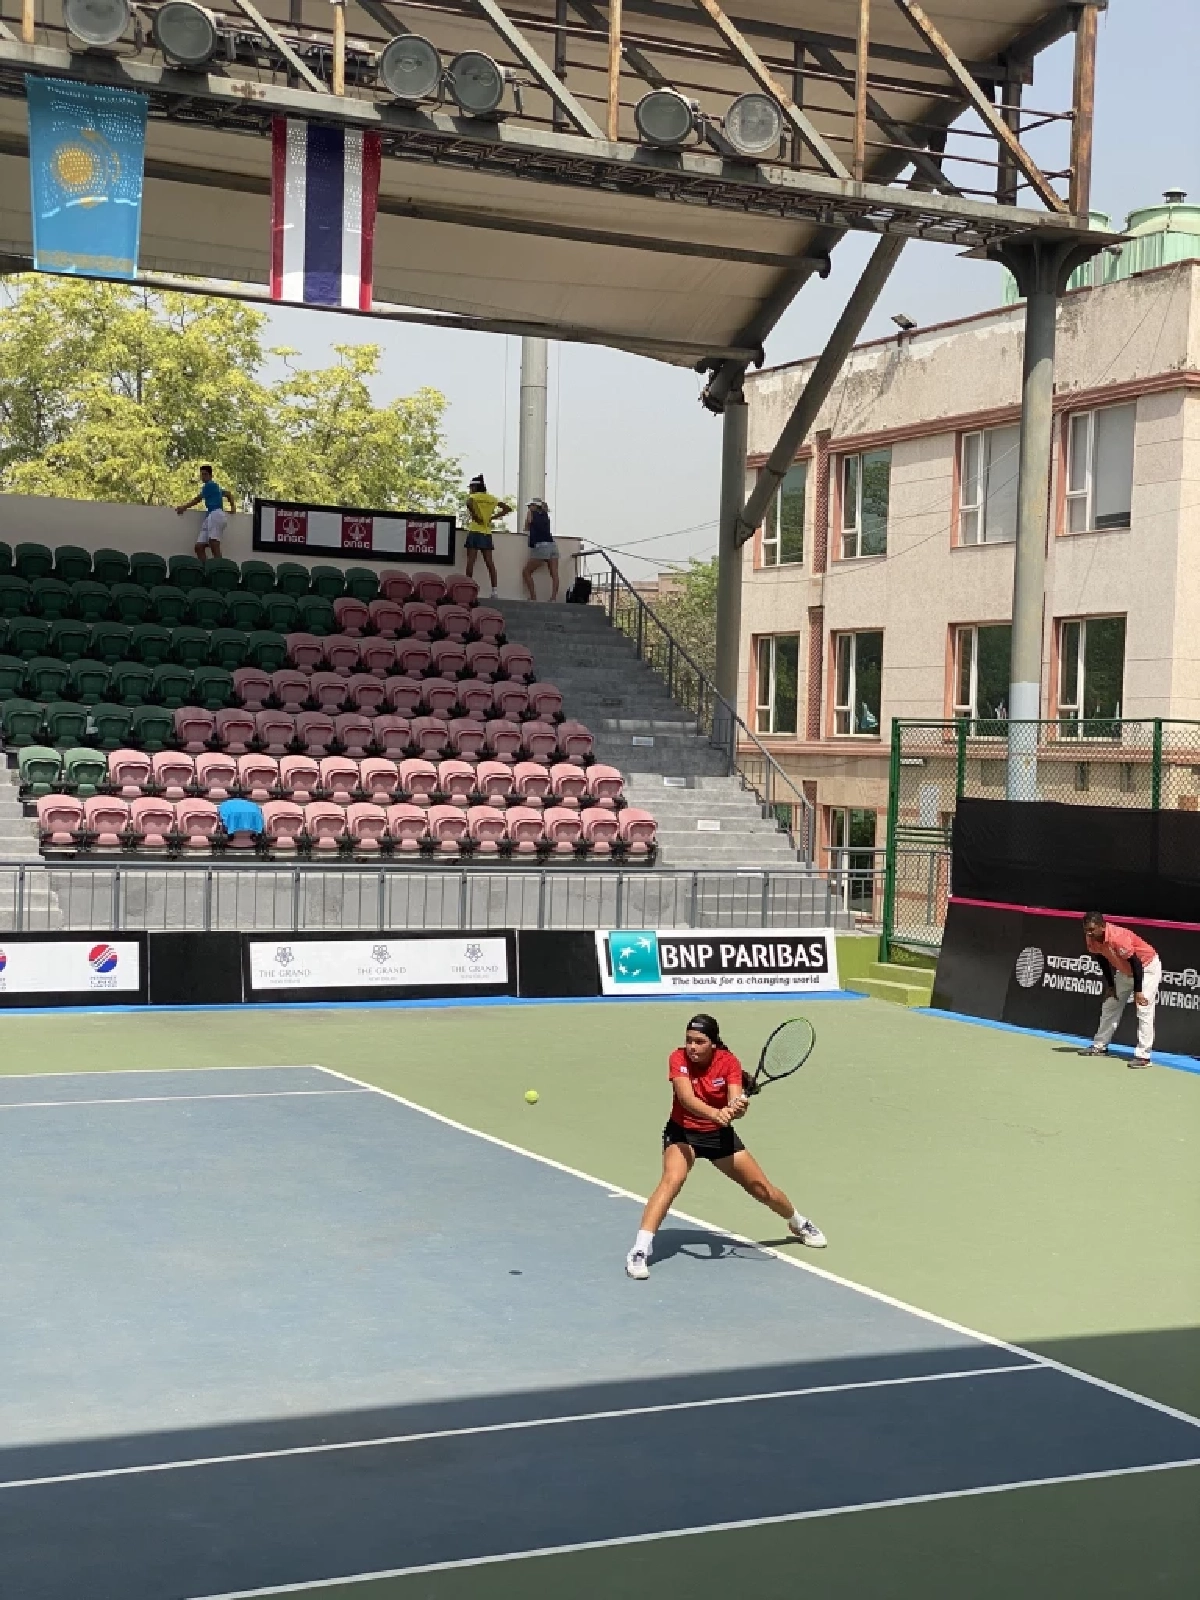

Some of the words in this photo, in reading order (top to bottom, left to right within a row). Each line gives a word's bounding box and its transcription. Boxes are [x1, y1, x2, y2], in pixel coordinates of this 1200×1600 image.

[660, 943, 713, 968] BNP
[719, 942, 824, 968] PARIBAS
[671, 976, 690, 985] The
[693, 976, 717, 985] bank
[718, 975, 735, 987] for
[746, 975, 790, 986] changing
[793, 974, 820, 984] world
[1042, 972, 1103, 996] POWERGRID
